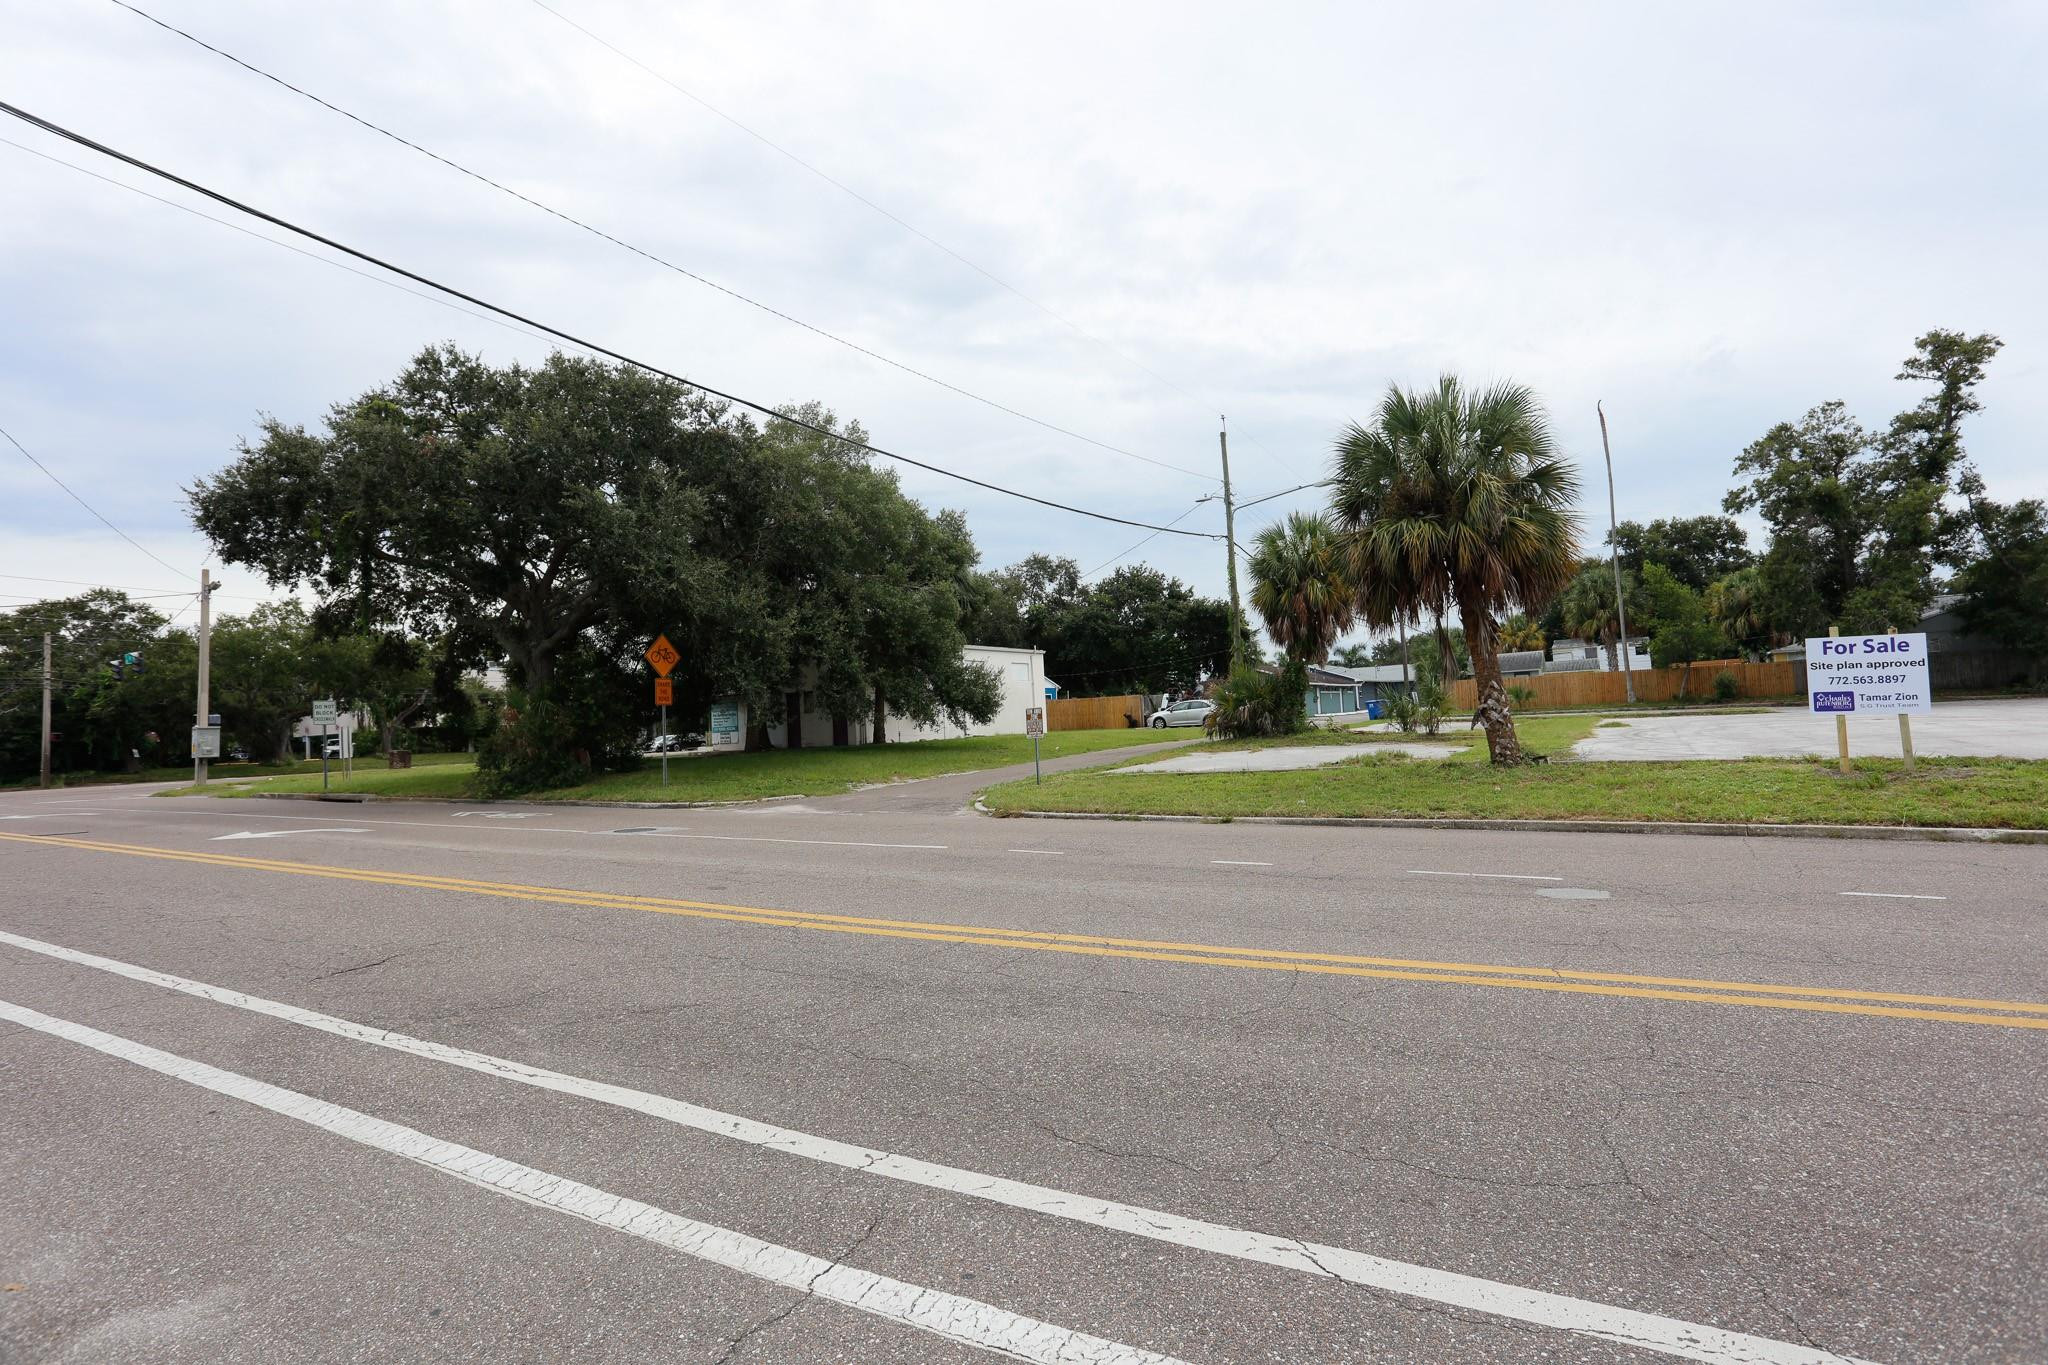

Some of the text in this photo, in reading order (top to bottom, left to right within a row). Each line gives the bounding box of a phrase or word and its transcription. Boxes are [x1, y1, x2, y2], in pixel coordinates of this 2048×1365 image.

[1822, 637, 1910, 655] For Sale
[1810, 658, 1925, 671] Site plan approved
[1828, 674, 1906, 685] 772.563.8897
[1859, 692, 1918, 701] Tamar Zion
